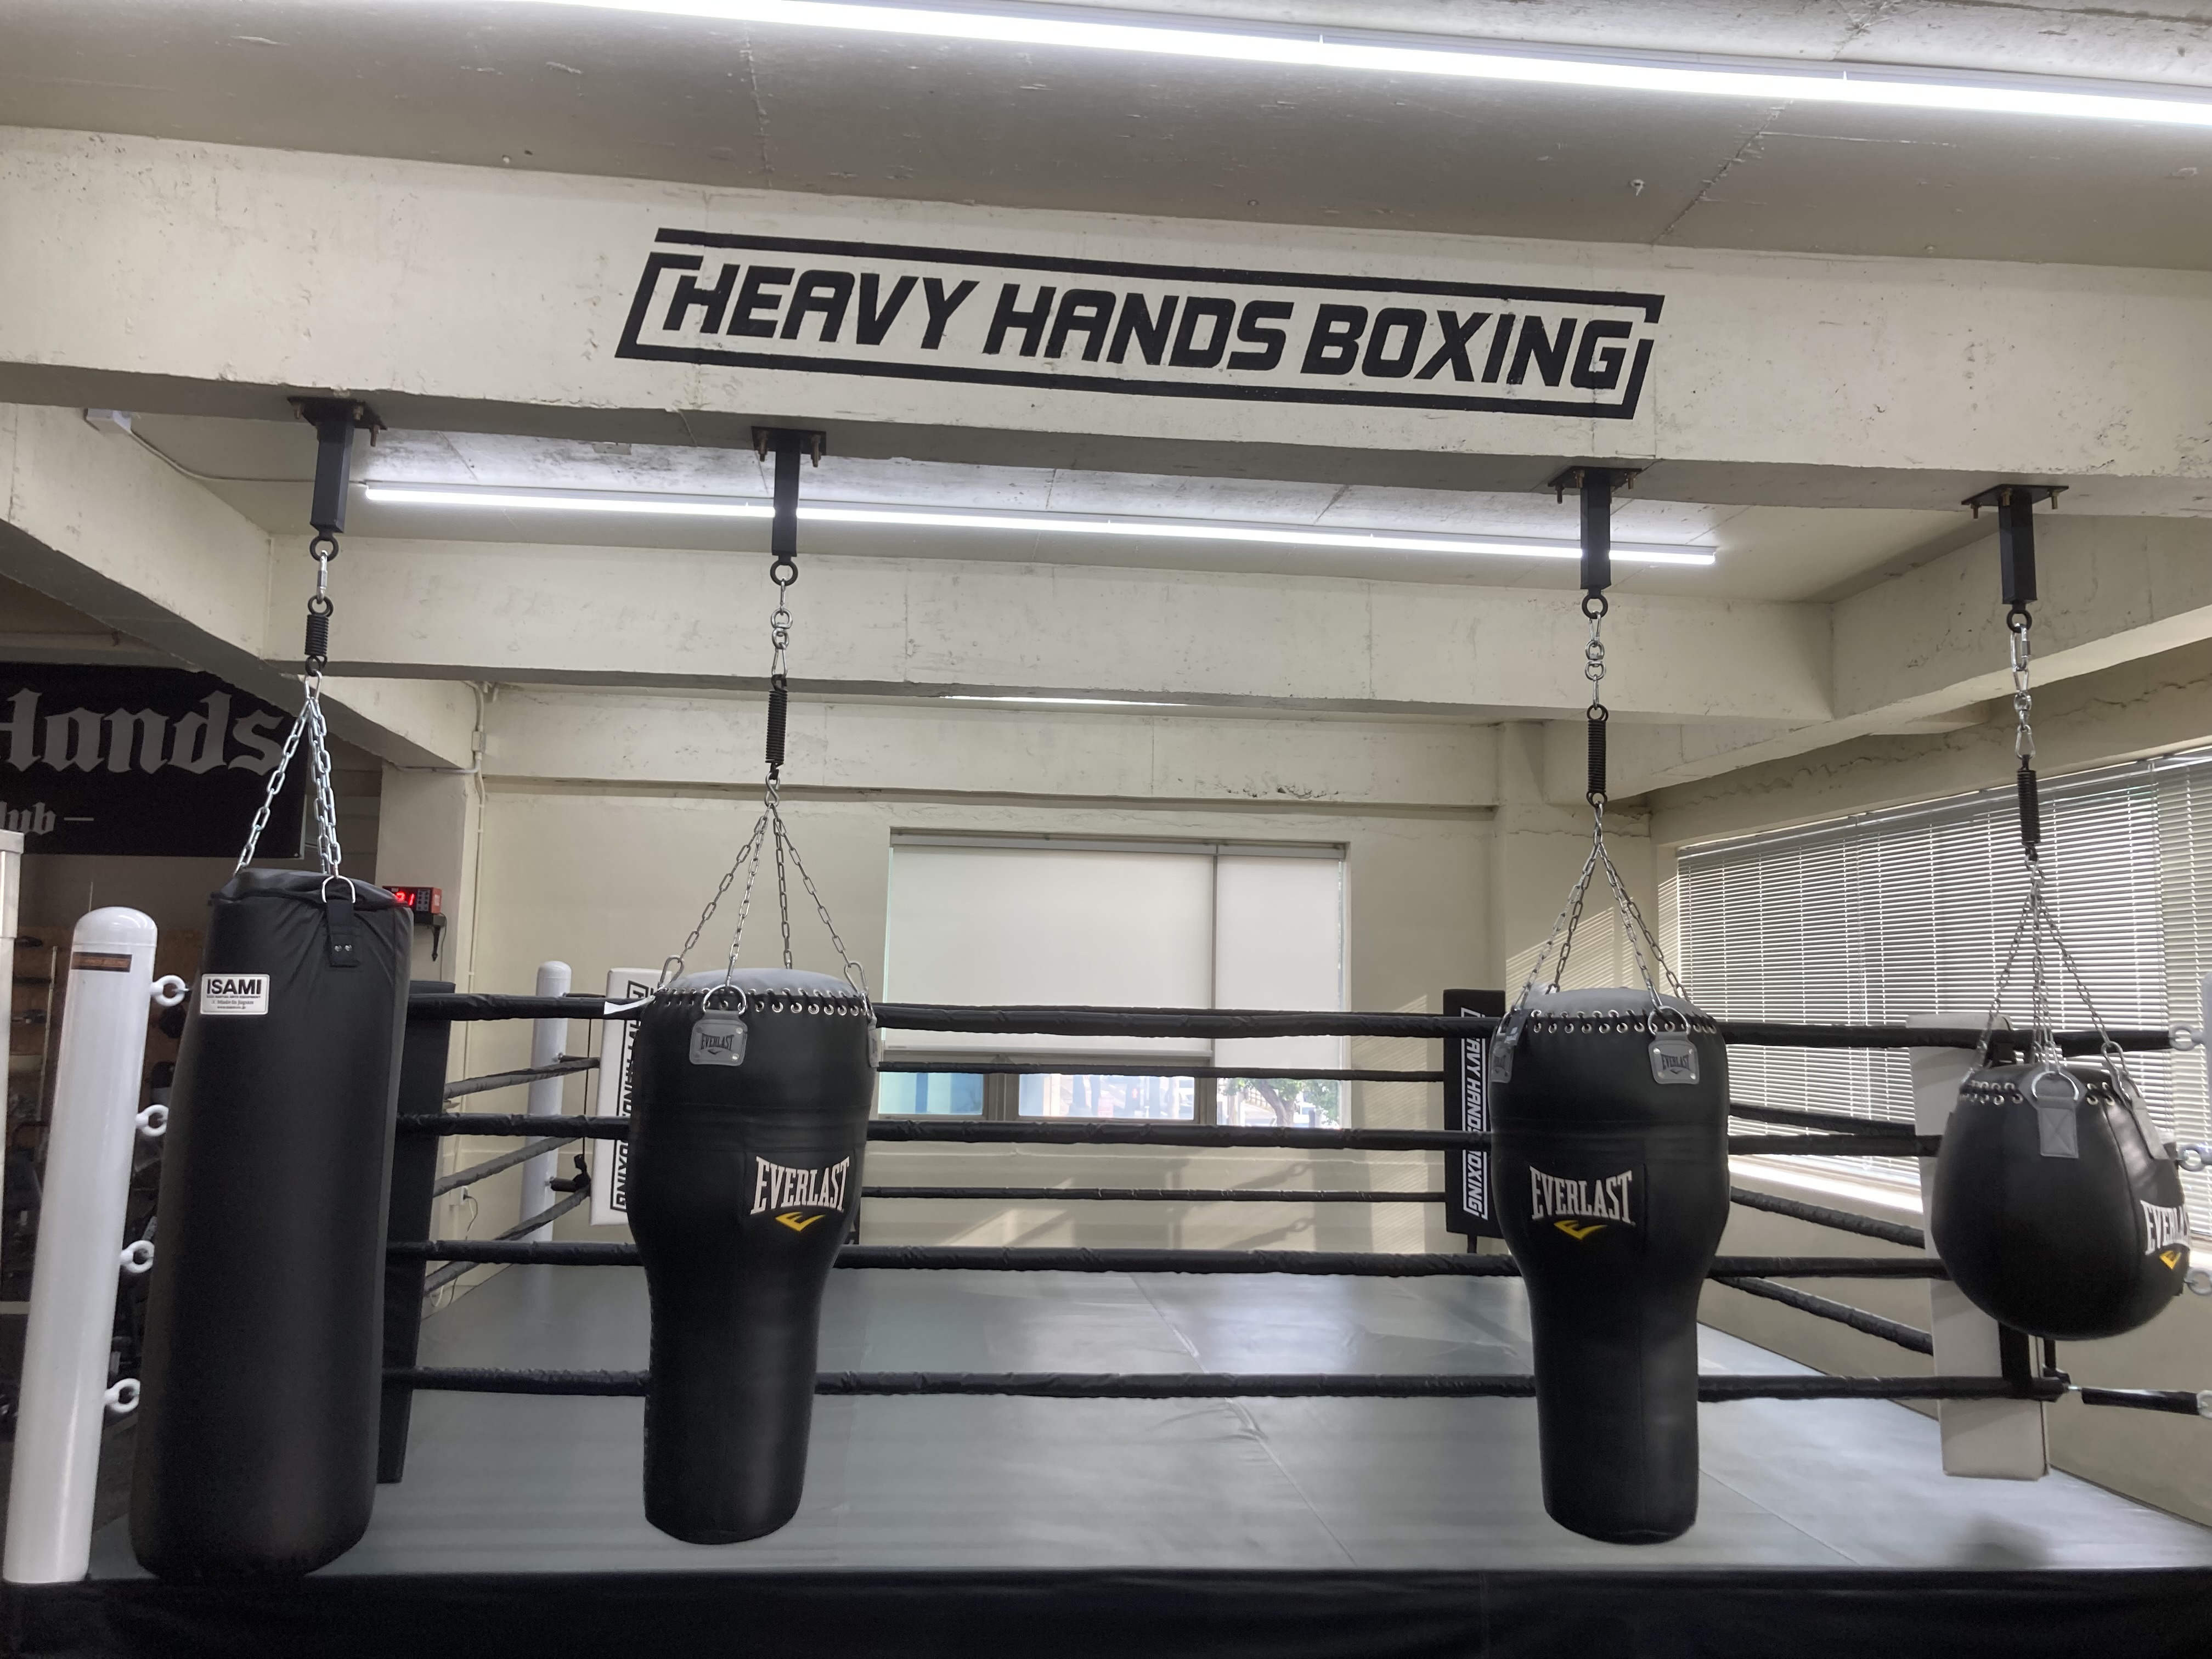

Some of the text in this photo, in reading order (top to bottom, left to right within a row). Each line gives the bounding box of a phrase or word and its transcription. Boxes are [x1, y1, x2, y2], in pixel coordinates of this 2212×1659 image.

[662, 263, 1633, 390] HEAVY HANDS BOXING
[0, 800, 56, 835] lub
[207, 979, 262, 995] ISAMI
[1466, 1038, 1481, 1077] AVY
[750, 1156, 850, 1215] EVERLAST
[1467, 1150, 1482, 1212] OXING
[1530, 1165, 1633, 1224] EVERLAST
